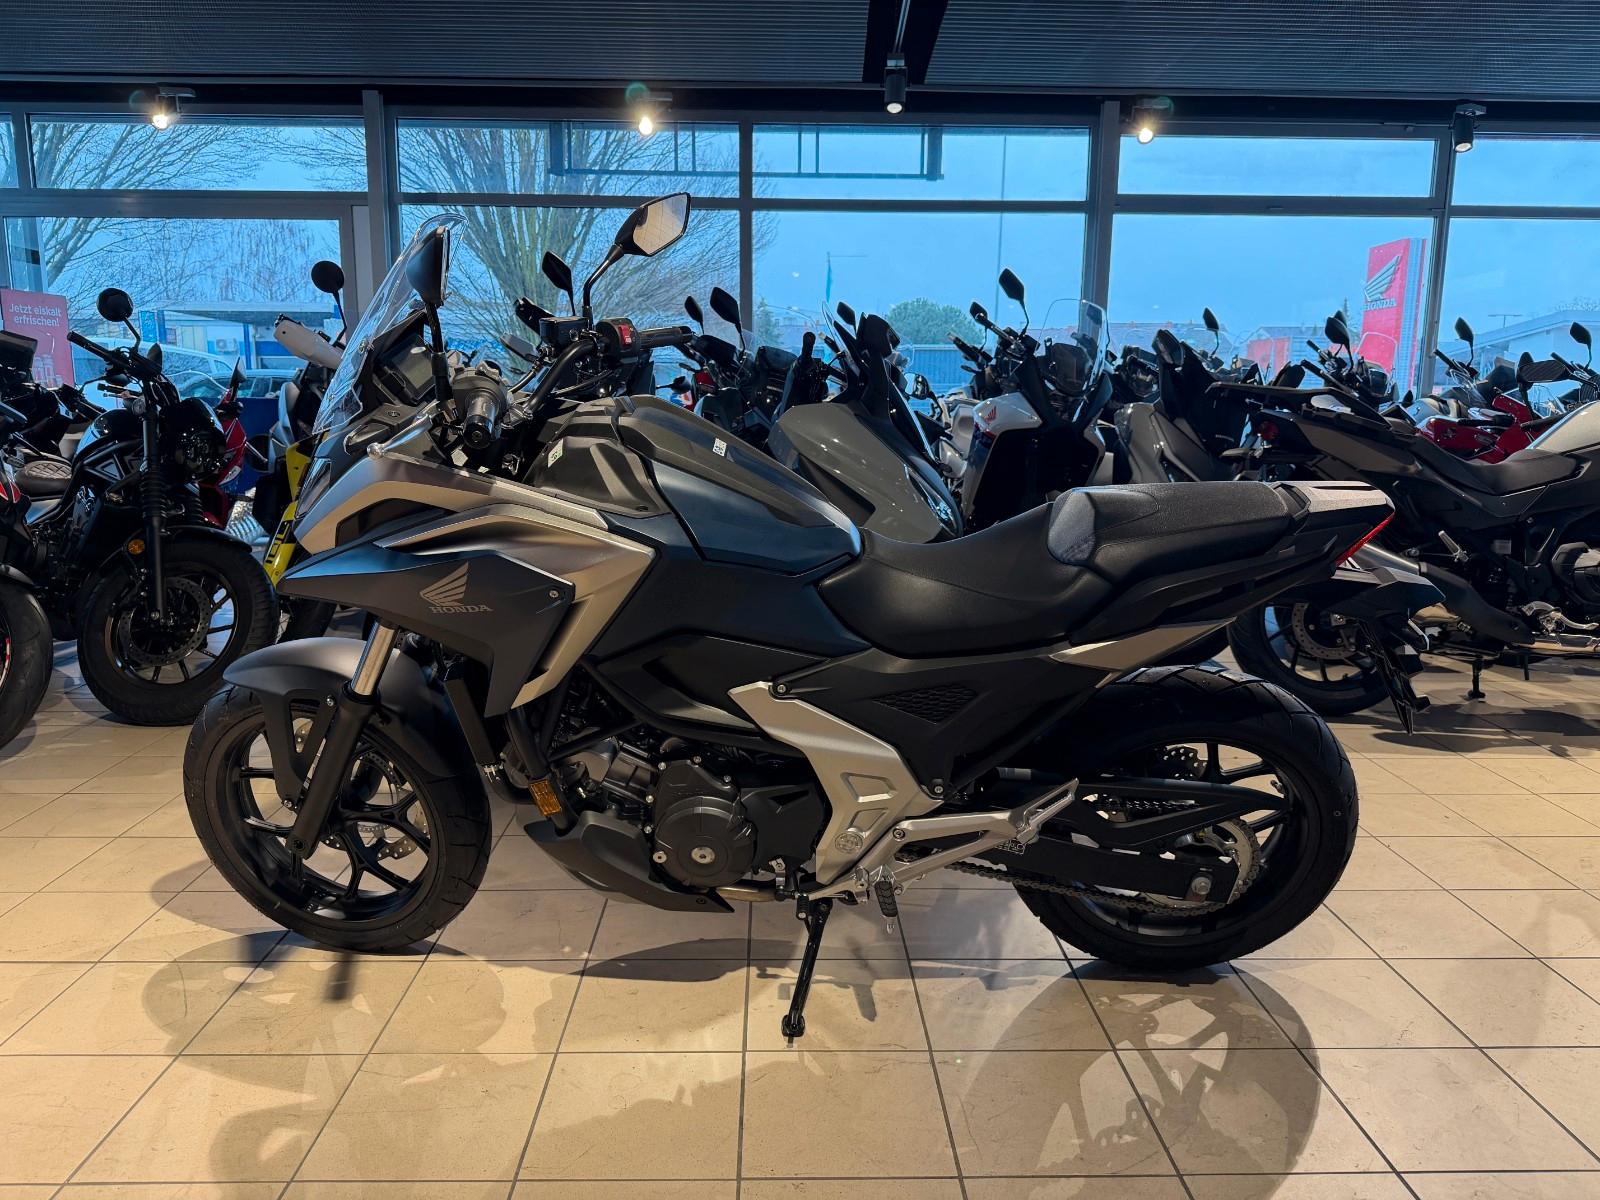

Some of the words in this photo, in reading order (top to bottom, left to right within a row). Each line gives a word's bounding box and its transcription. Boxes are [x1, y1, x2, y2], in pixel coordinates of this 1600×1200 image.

[9, 303, 32, 314] Jetzt
[33, 305, 61, 317] eiskalt
[1363, 298, 1397, 311] HONDA
[14, 315, 60, 327] erfrischen!
[428, 604, 493, 614] HONDA
